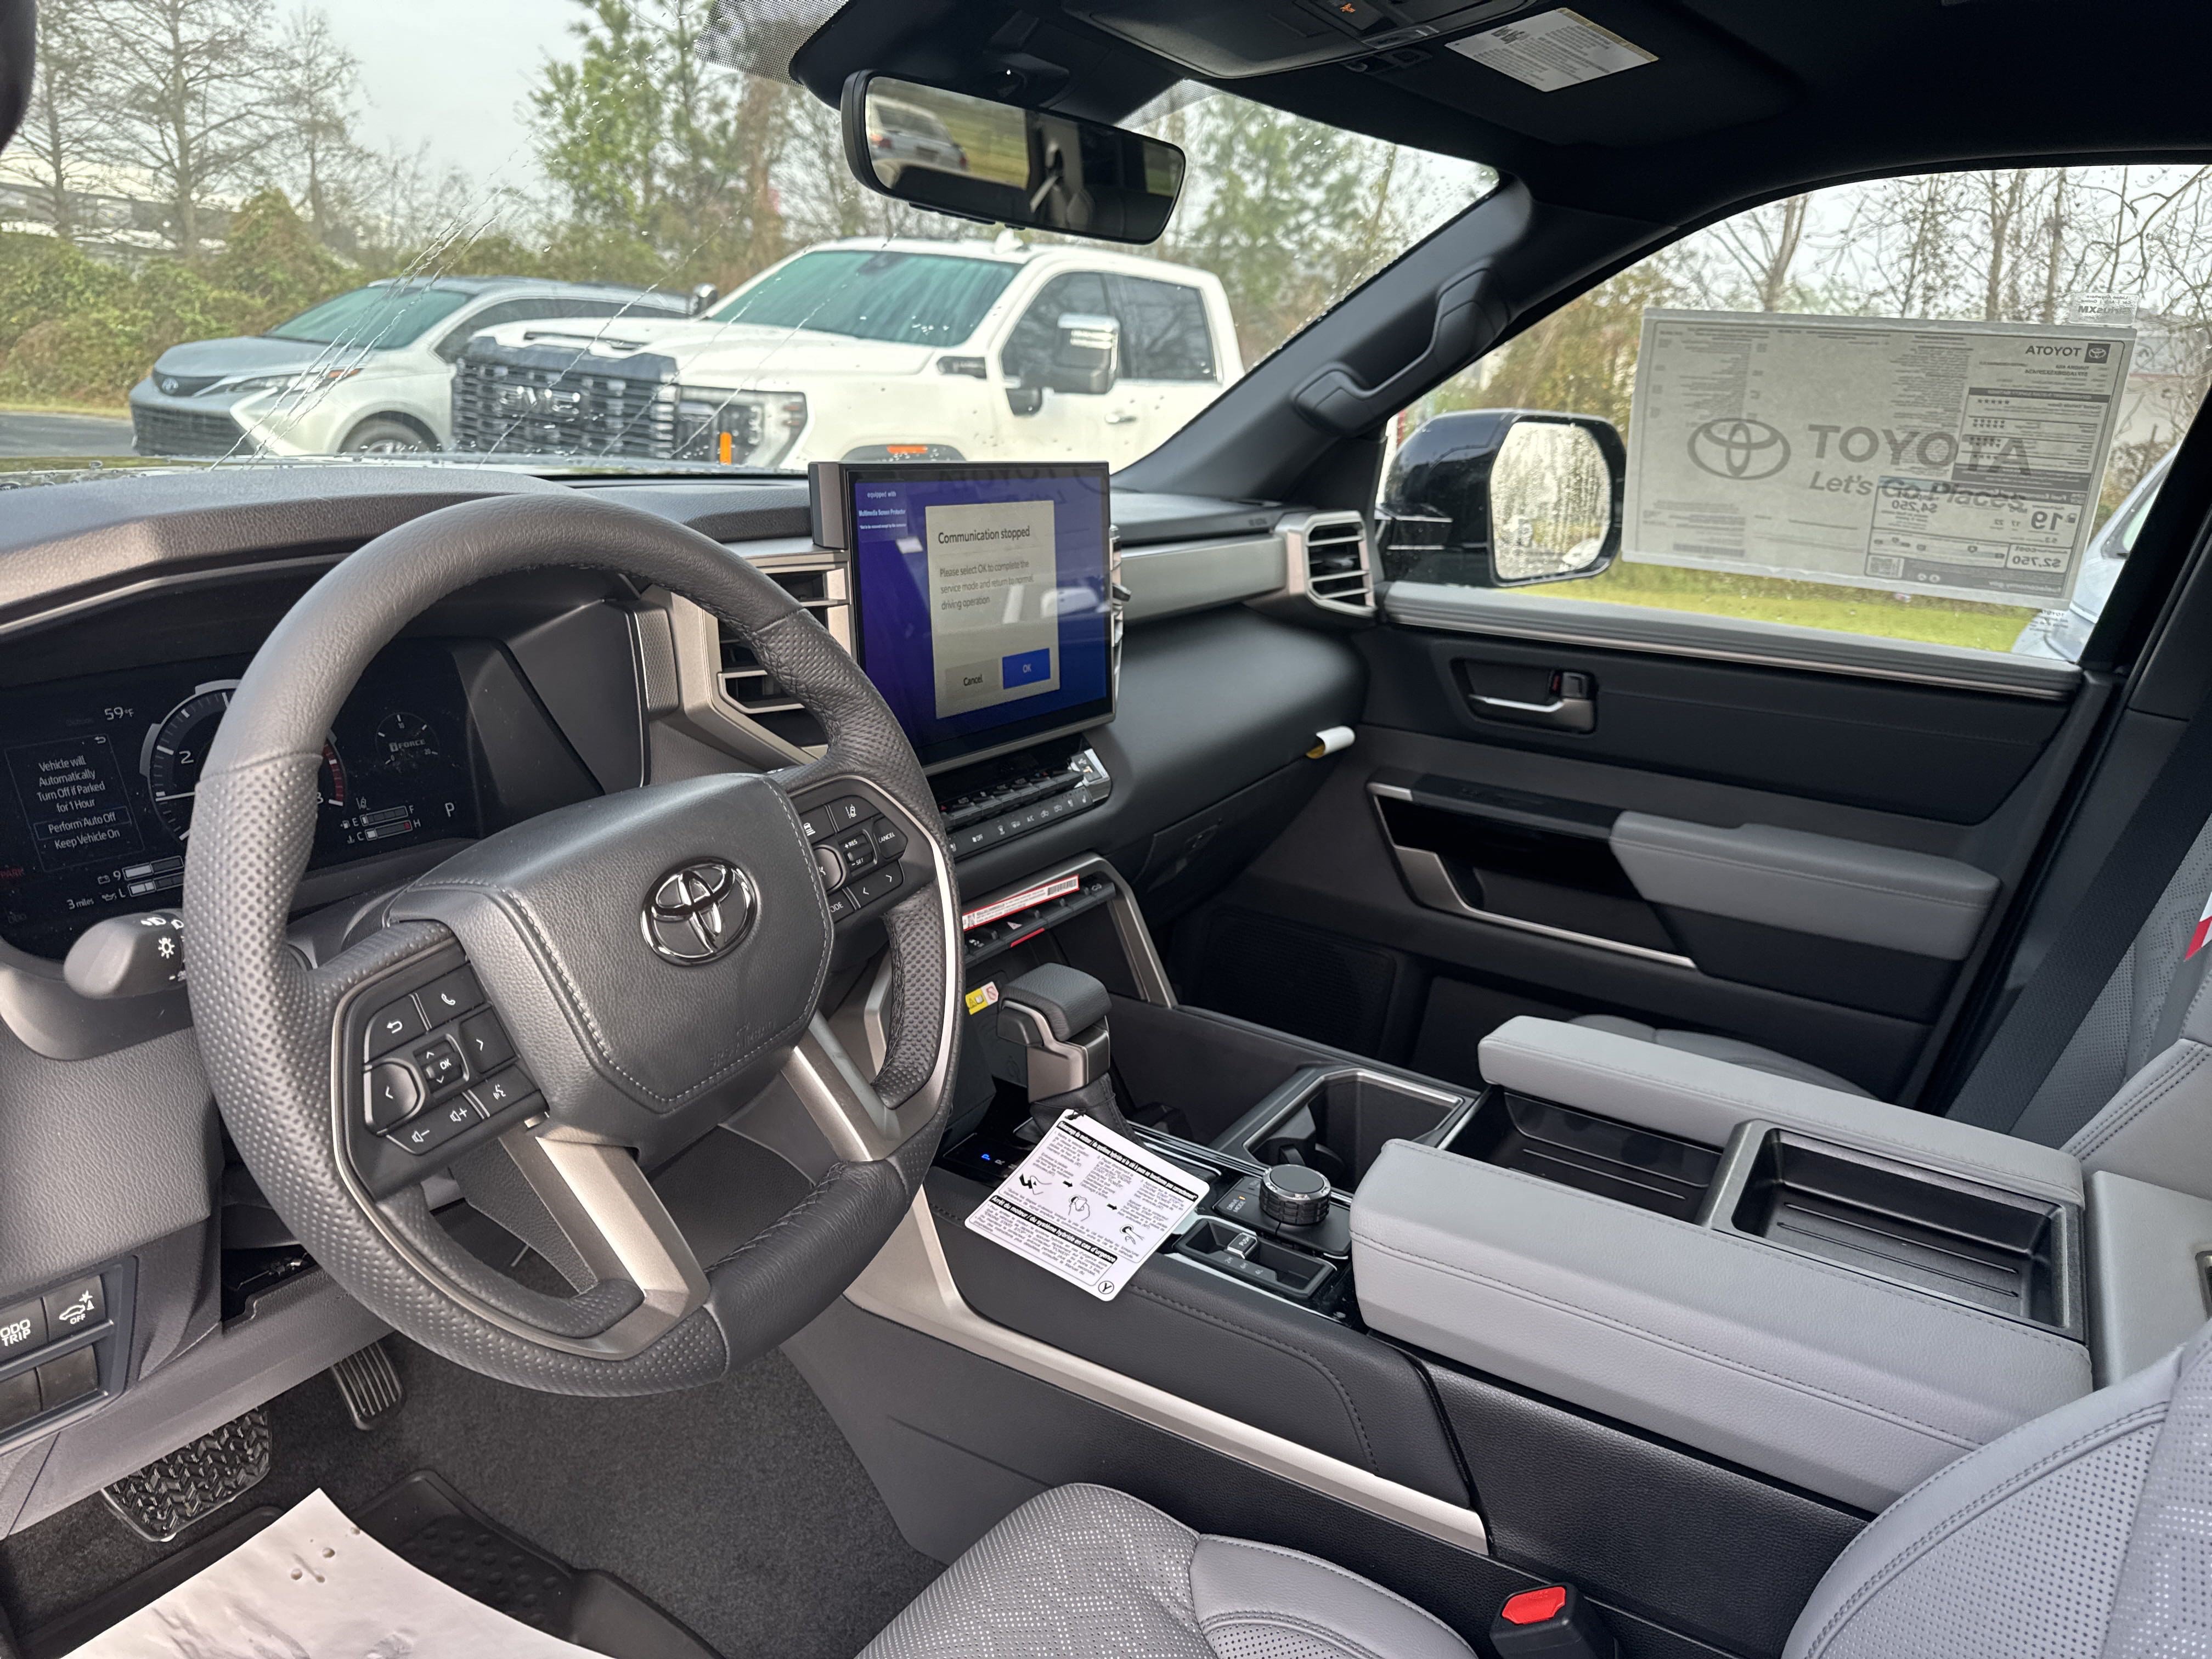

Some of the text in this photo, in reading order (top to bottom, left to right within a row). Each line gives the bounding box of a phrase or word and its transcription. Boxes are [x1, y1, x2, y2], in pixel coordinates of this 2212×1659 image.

[1808, 425, 2030, 476] TOYOTA
[1810, 471, 1874, 495] Let's
[1931, 482, 2025, 510] Places
[938, 526, 1030, 544] Communication stopped
[940, 567, 959, 577] Please
[961, 565, 977, 574] select
[978, 564, 987, 573] OK
[995, 561, 1019, 572] complete
[941, 584, 961, 594] service
[962, 582, 979, 591] mode
[979, 580, 990, 589] and
[991, 578, 1007, 587] return
[1014, 575, 1034, 584] normal
[941, 596, 990, 610] driving operation
[1022, 664, 1031, 673] OK
[963, 674, 983, 686] Cancel
[38, 755, 87, 772] Vehicle will
[179, 750, 194, 764] 2
[39, 769, 95, 787] Automatically
[37, 781, 105, 802] Turn Off if Parked
[57, 799, 95, 812] for 1 Hour
[444, 802, 455, 817] P
[48, 812, 117, 834] Perform Auto Off
[352, 805, 414, 827] E F
[357, 819, 421, 841] C H
[879, 832, 895, 844] CANCEL
[54, 829, 121, 850] Keep Vehicle On
[113, 871, 121, 881] 9
[119, 888, 126, 898] L
[66, 898, 94, 910] 3 miles
[830, 901, 844, 913] ODE
[439, 1058, 452, 1071] OK
[990, 1195, 1006, 1206] Arrêt
[1009, 1205, 1029, 1218] moteur
[1034, 1218, 1058, 1234] système
[1054, 1229, 1076, 1243] hybride
[1080, 1242, 1092, 1250] cas
[1088, 1246, 1117, 1264] d'urgence
[1102, 1283, 1111, 1293] Y
[70, 1314, 86, 1325] OFF
[0, 1319, 31, 1339] ODO
[1, 1328, 31, 1346] TRIP
